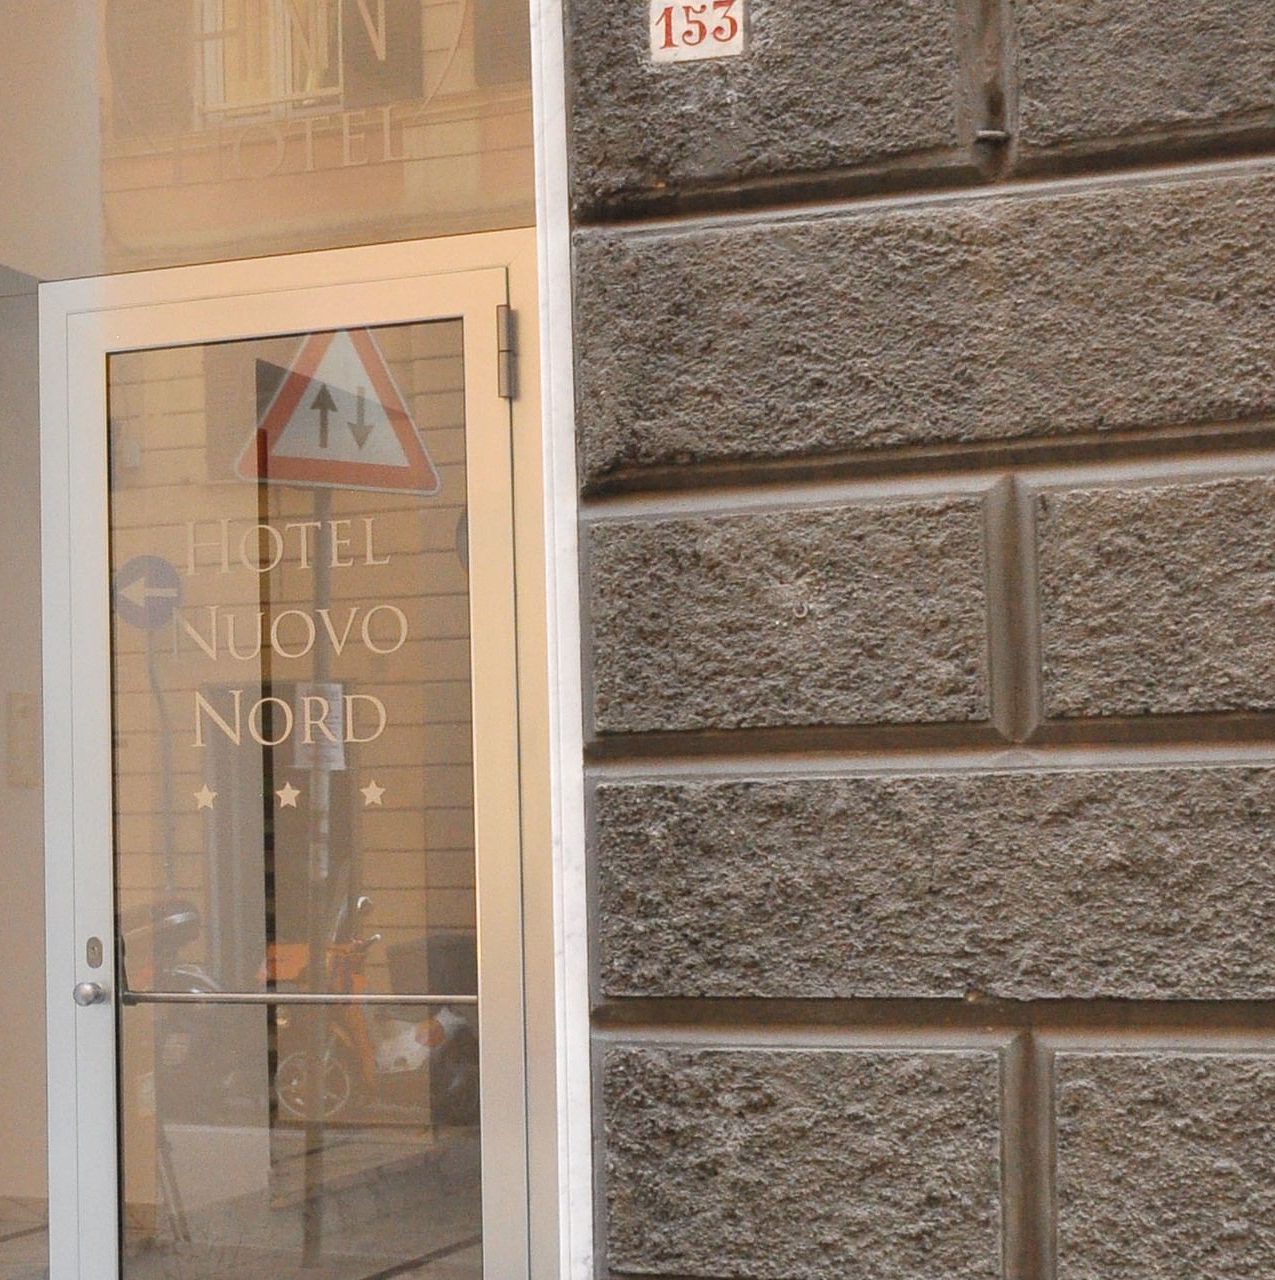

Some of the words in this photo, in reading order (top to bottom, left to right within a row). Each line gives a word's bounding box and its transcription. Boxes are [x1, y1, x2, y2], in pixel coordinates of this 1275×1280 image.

[184, 517, 392, 577] HOTEL
[172, 603, 409, 662] NUOVO
[190, 689, 389, 749] NORD
